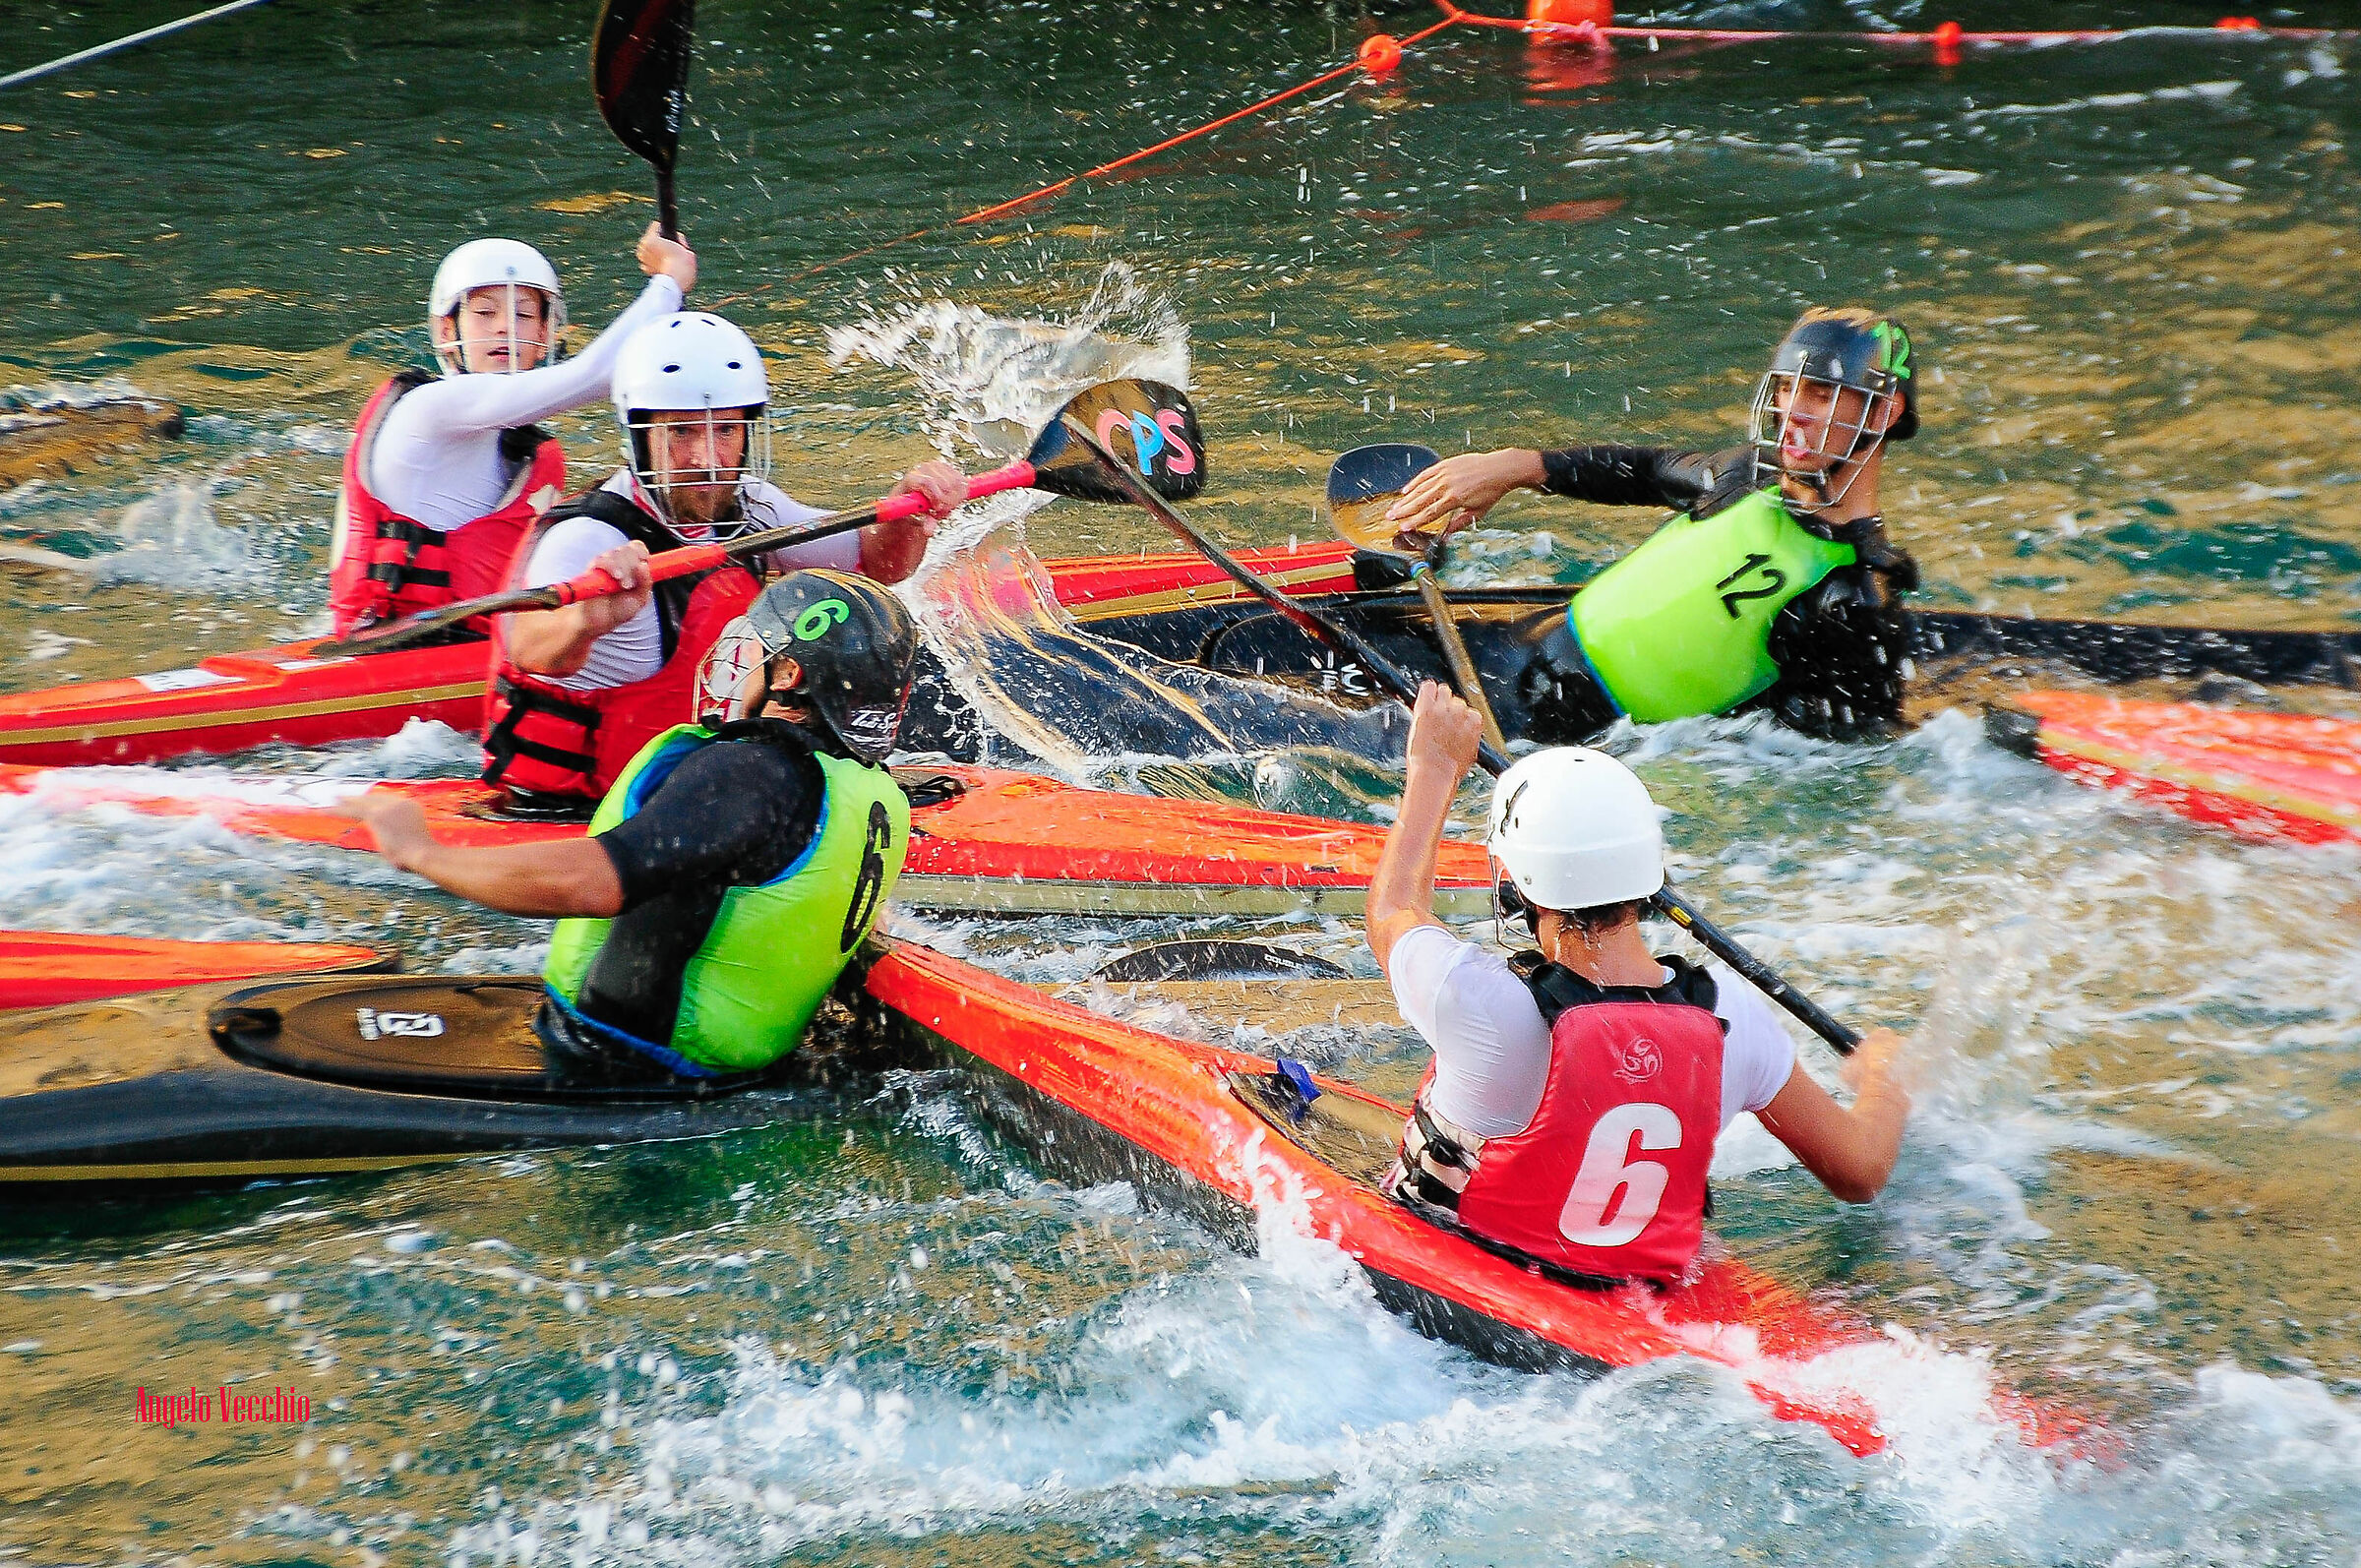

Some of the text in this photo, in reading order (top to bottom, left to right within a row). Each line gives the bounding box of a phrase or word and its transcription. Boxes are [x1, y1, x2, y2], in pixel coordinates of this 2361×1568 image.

[1872, 321, 1911, 379] 12
[1096, 408, 1195, 475] CPS
[794, 598, 849, 641] 6
[1717, 554, 1786, 620] 12
[841, 801, 890, 953] 6
[1559, 1103, 1683, 1246] 6
